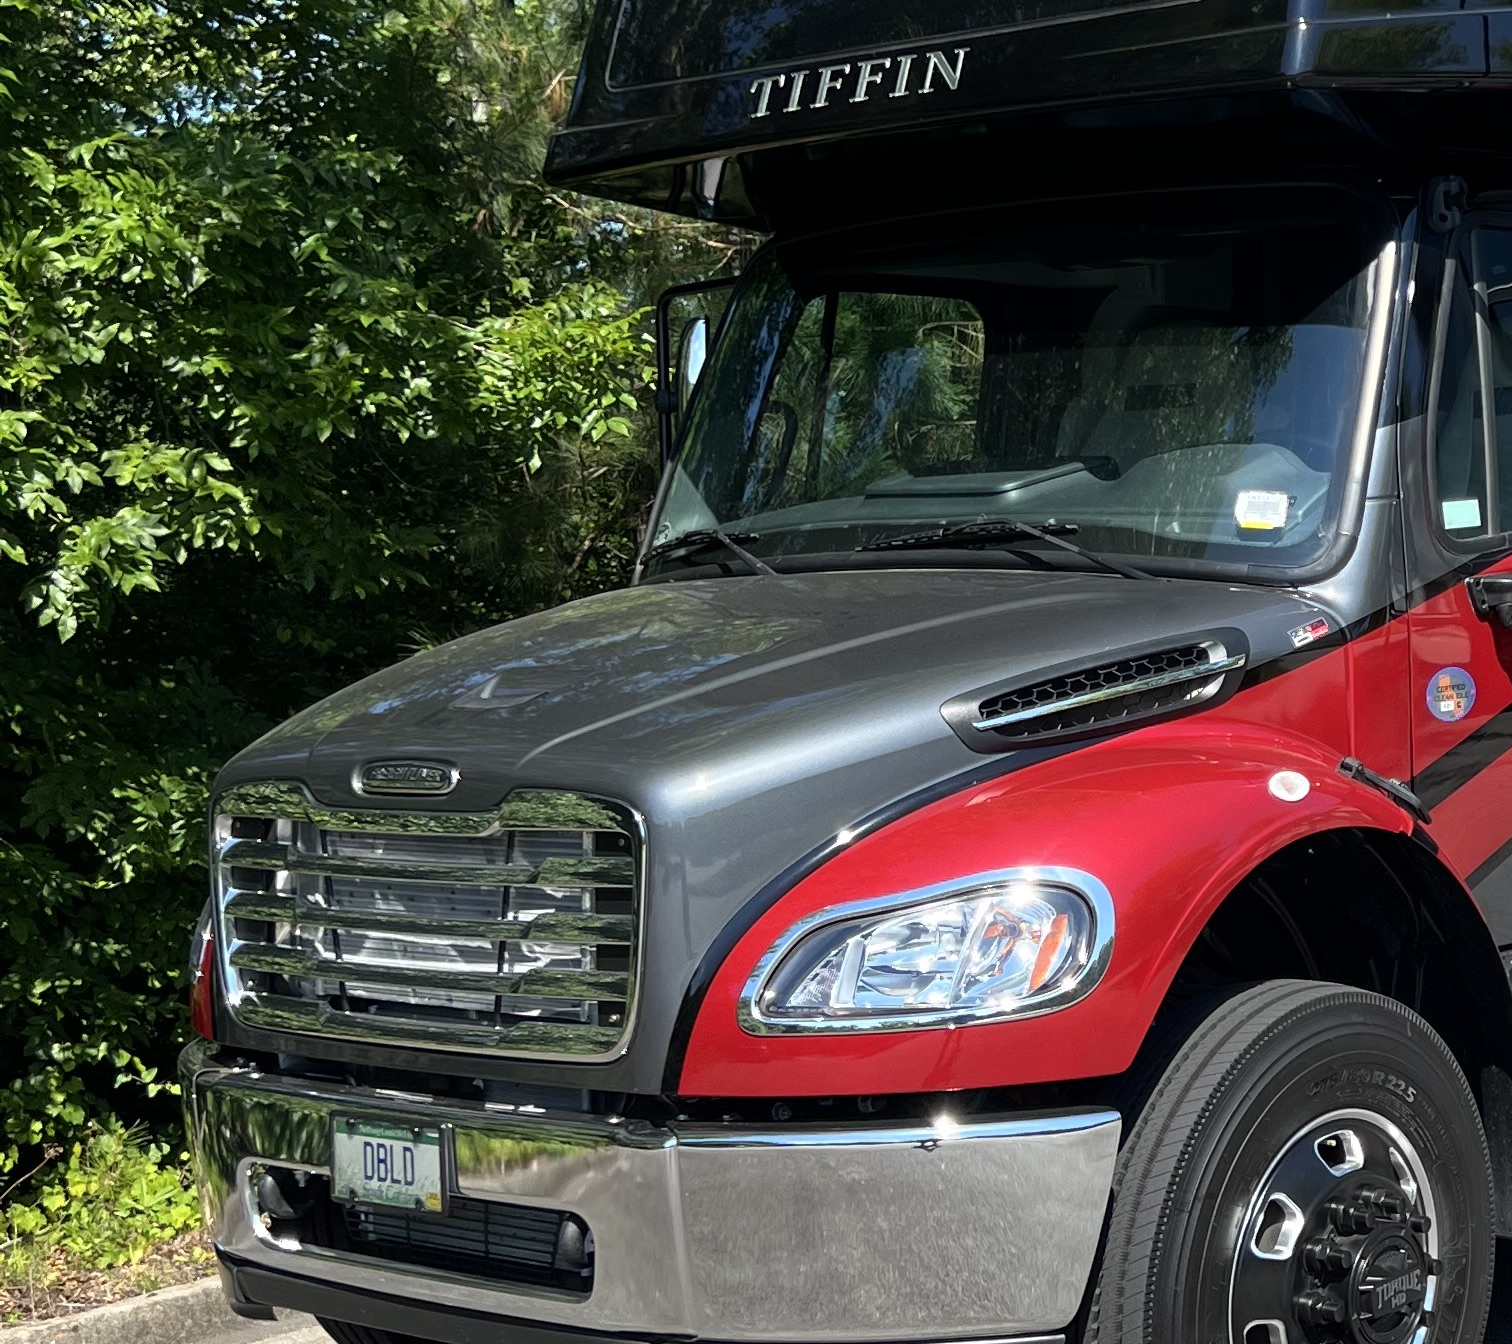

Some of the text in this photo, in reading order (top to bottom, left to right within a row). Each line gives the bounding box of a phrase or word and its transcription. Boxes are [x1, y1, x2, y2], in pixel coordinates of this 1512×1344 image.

[750, 47, 970, 118] TIFFIN
[363, 1141, 415, 1186] DBLD
[1376, 1269, 1421, 1309] TORQUE
[1391, 1292, 1406, 1308] HD
